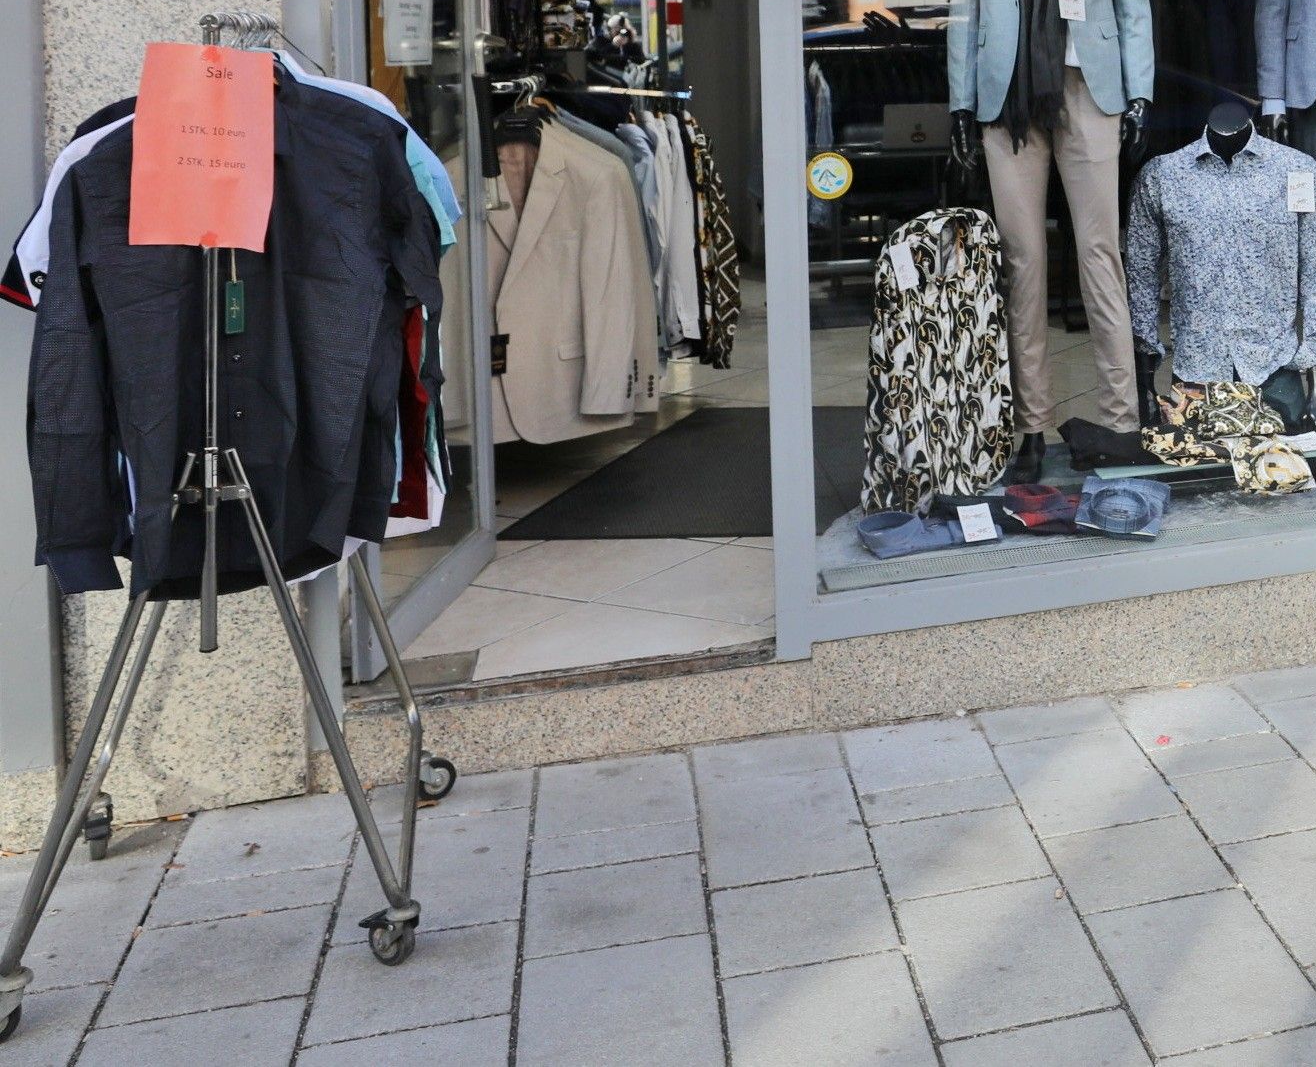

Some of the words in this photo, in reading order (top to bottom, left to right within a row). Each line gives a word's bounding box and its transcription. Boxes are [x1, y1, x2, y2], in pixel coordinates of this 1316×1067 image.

[205, 66, 234, 80] Sale
[212, 126, 225, 137] 10
[226, 128, 246, 138] euro
[176, 156, 184, 165] 2
[208, 159, 222, 169] 15
[224, 159, 246, 169] euro
